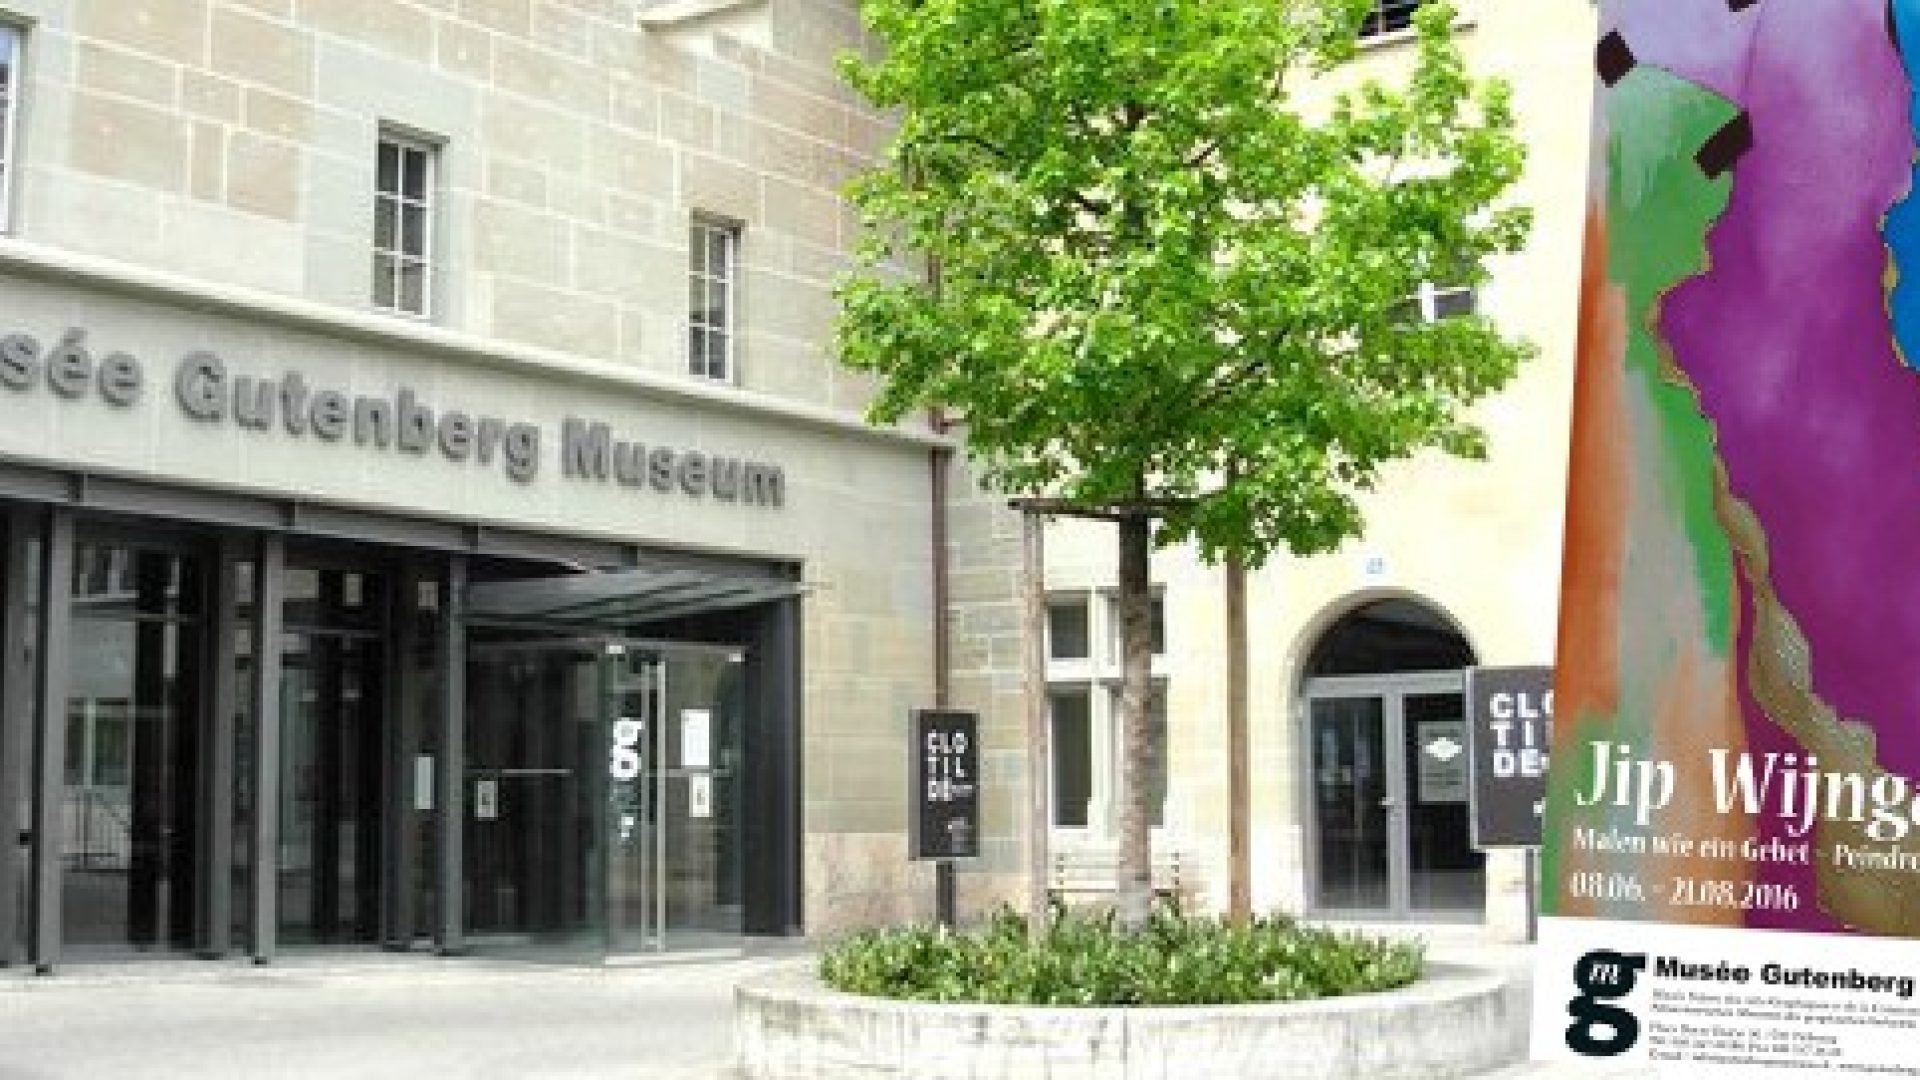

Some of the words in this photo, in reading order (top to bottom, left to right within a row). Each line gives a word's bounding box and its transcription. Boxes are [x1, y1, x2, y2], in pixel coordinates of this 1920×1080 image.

[0, 327, 143, 408] sée
[175, 350, 540, 484] Gutenberg
[561, 416, 785, 508] Museum
[927, 730, 968, 754] CLO
[1573, 740, 1675, 826] Jip
[1572, 826, 1647, 854] Malen
[1651, 831, 1694, 858] wie
[1698, 836, 1734, 861] ein
[1741, 837, 1809, 866] Gebet
[1653, 955, 1752, 984] Musée
[1761, 960, 1916, 1000] Gutenberg
